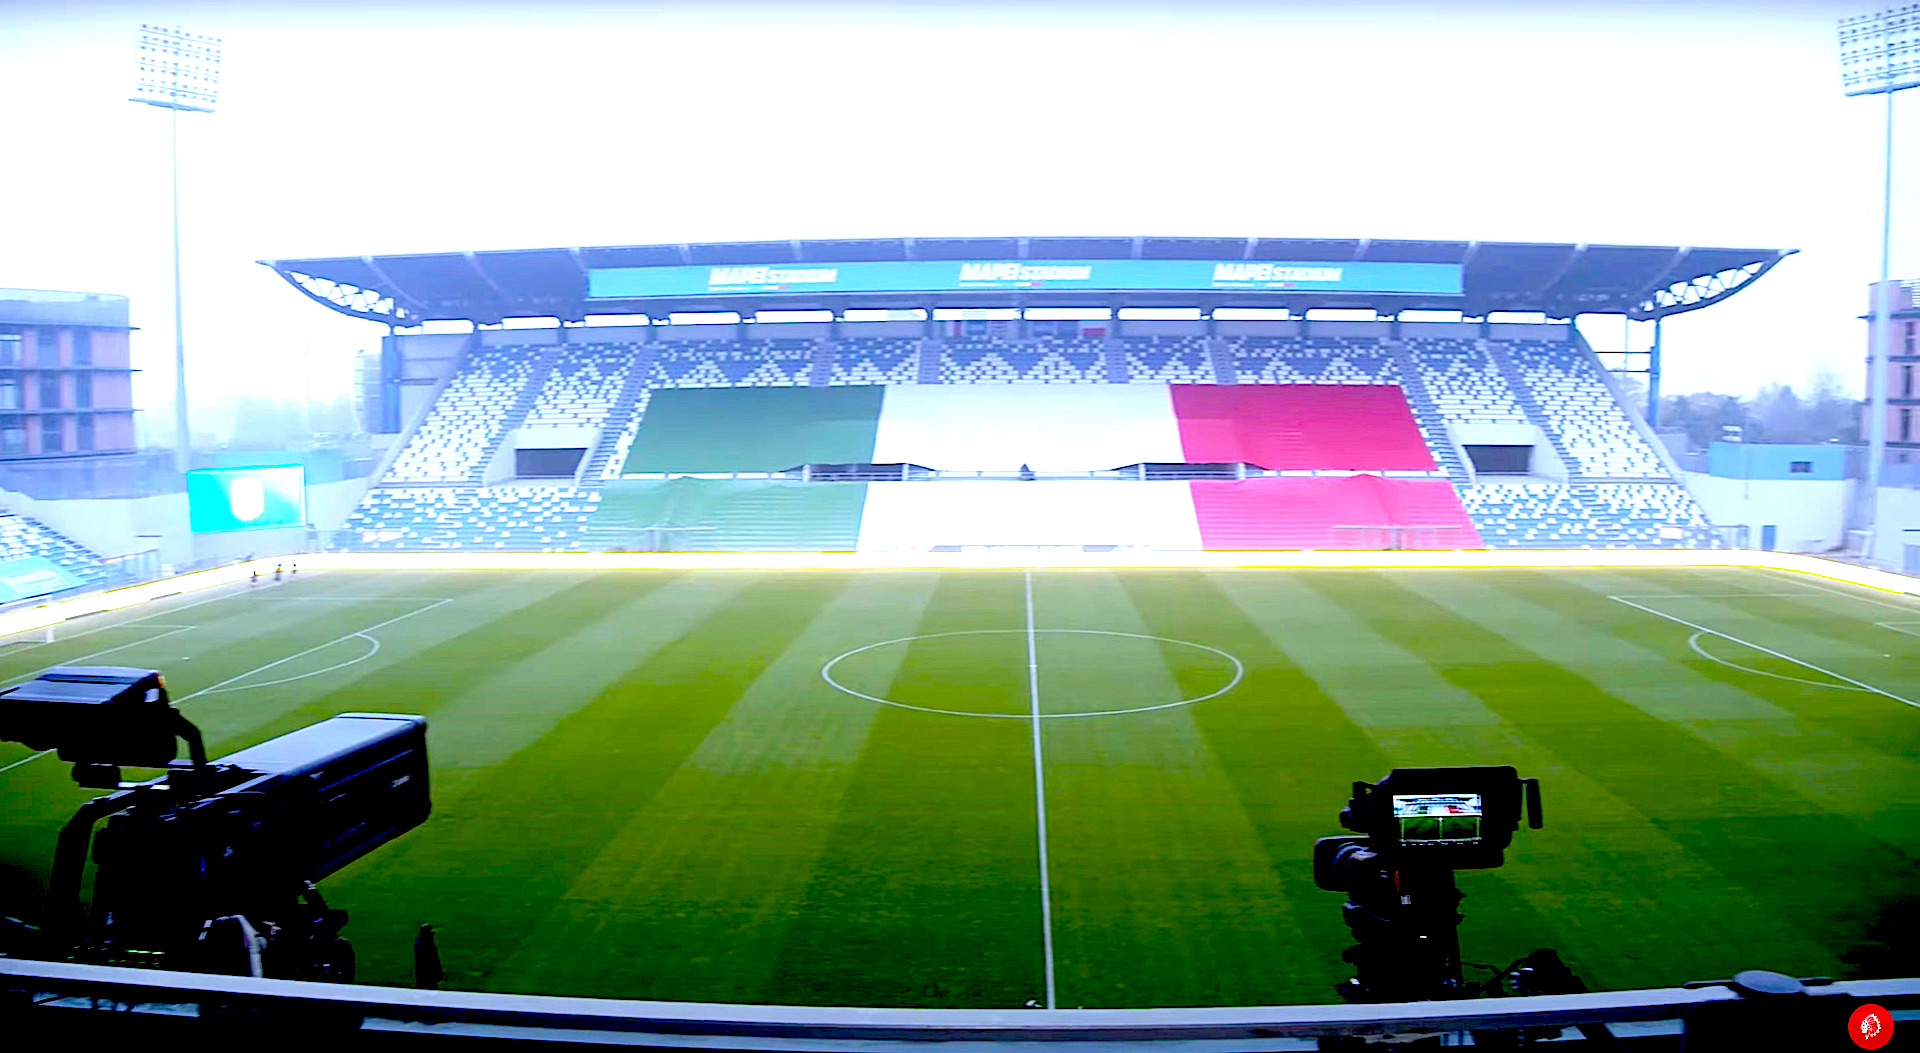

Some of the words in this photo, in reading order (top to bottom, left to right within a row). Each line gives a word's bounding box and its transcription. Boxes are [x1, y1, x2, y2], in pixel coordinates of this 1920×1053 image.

[709, 267, 769, 285] MAPEI
[767, 269, 838, 283] STADIUM
[959, 263, 1021, 280] MAPEI
[1019, 266, 1092, 280] STADIUM
[1213, 264, 1274, 281] MAPEI
[1272, 267, 1342, 281] STADIUM
